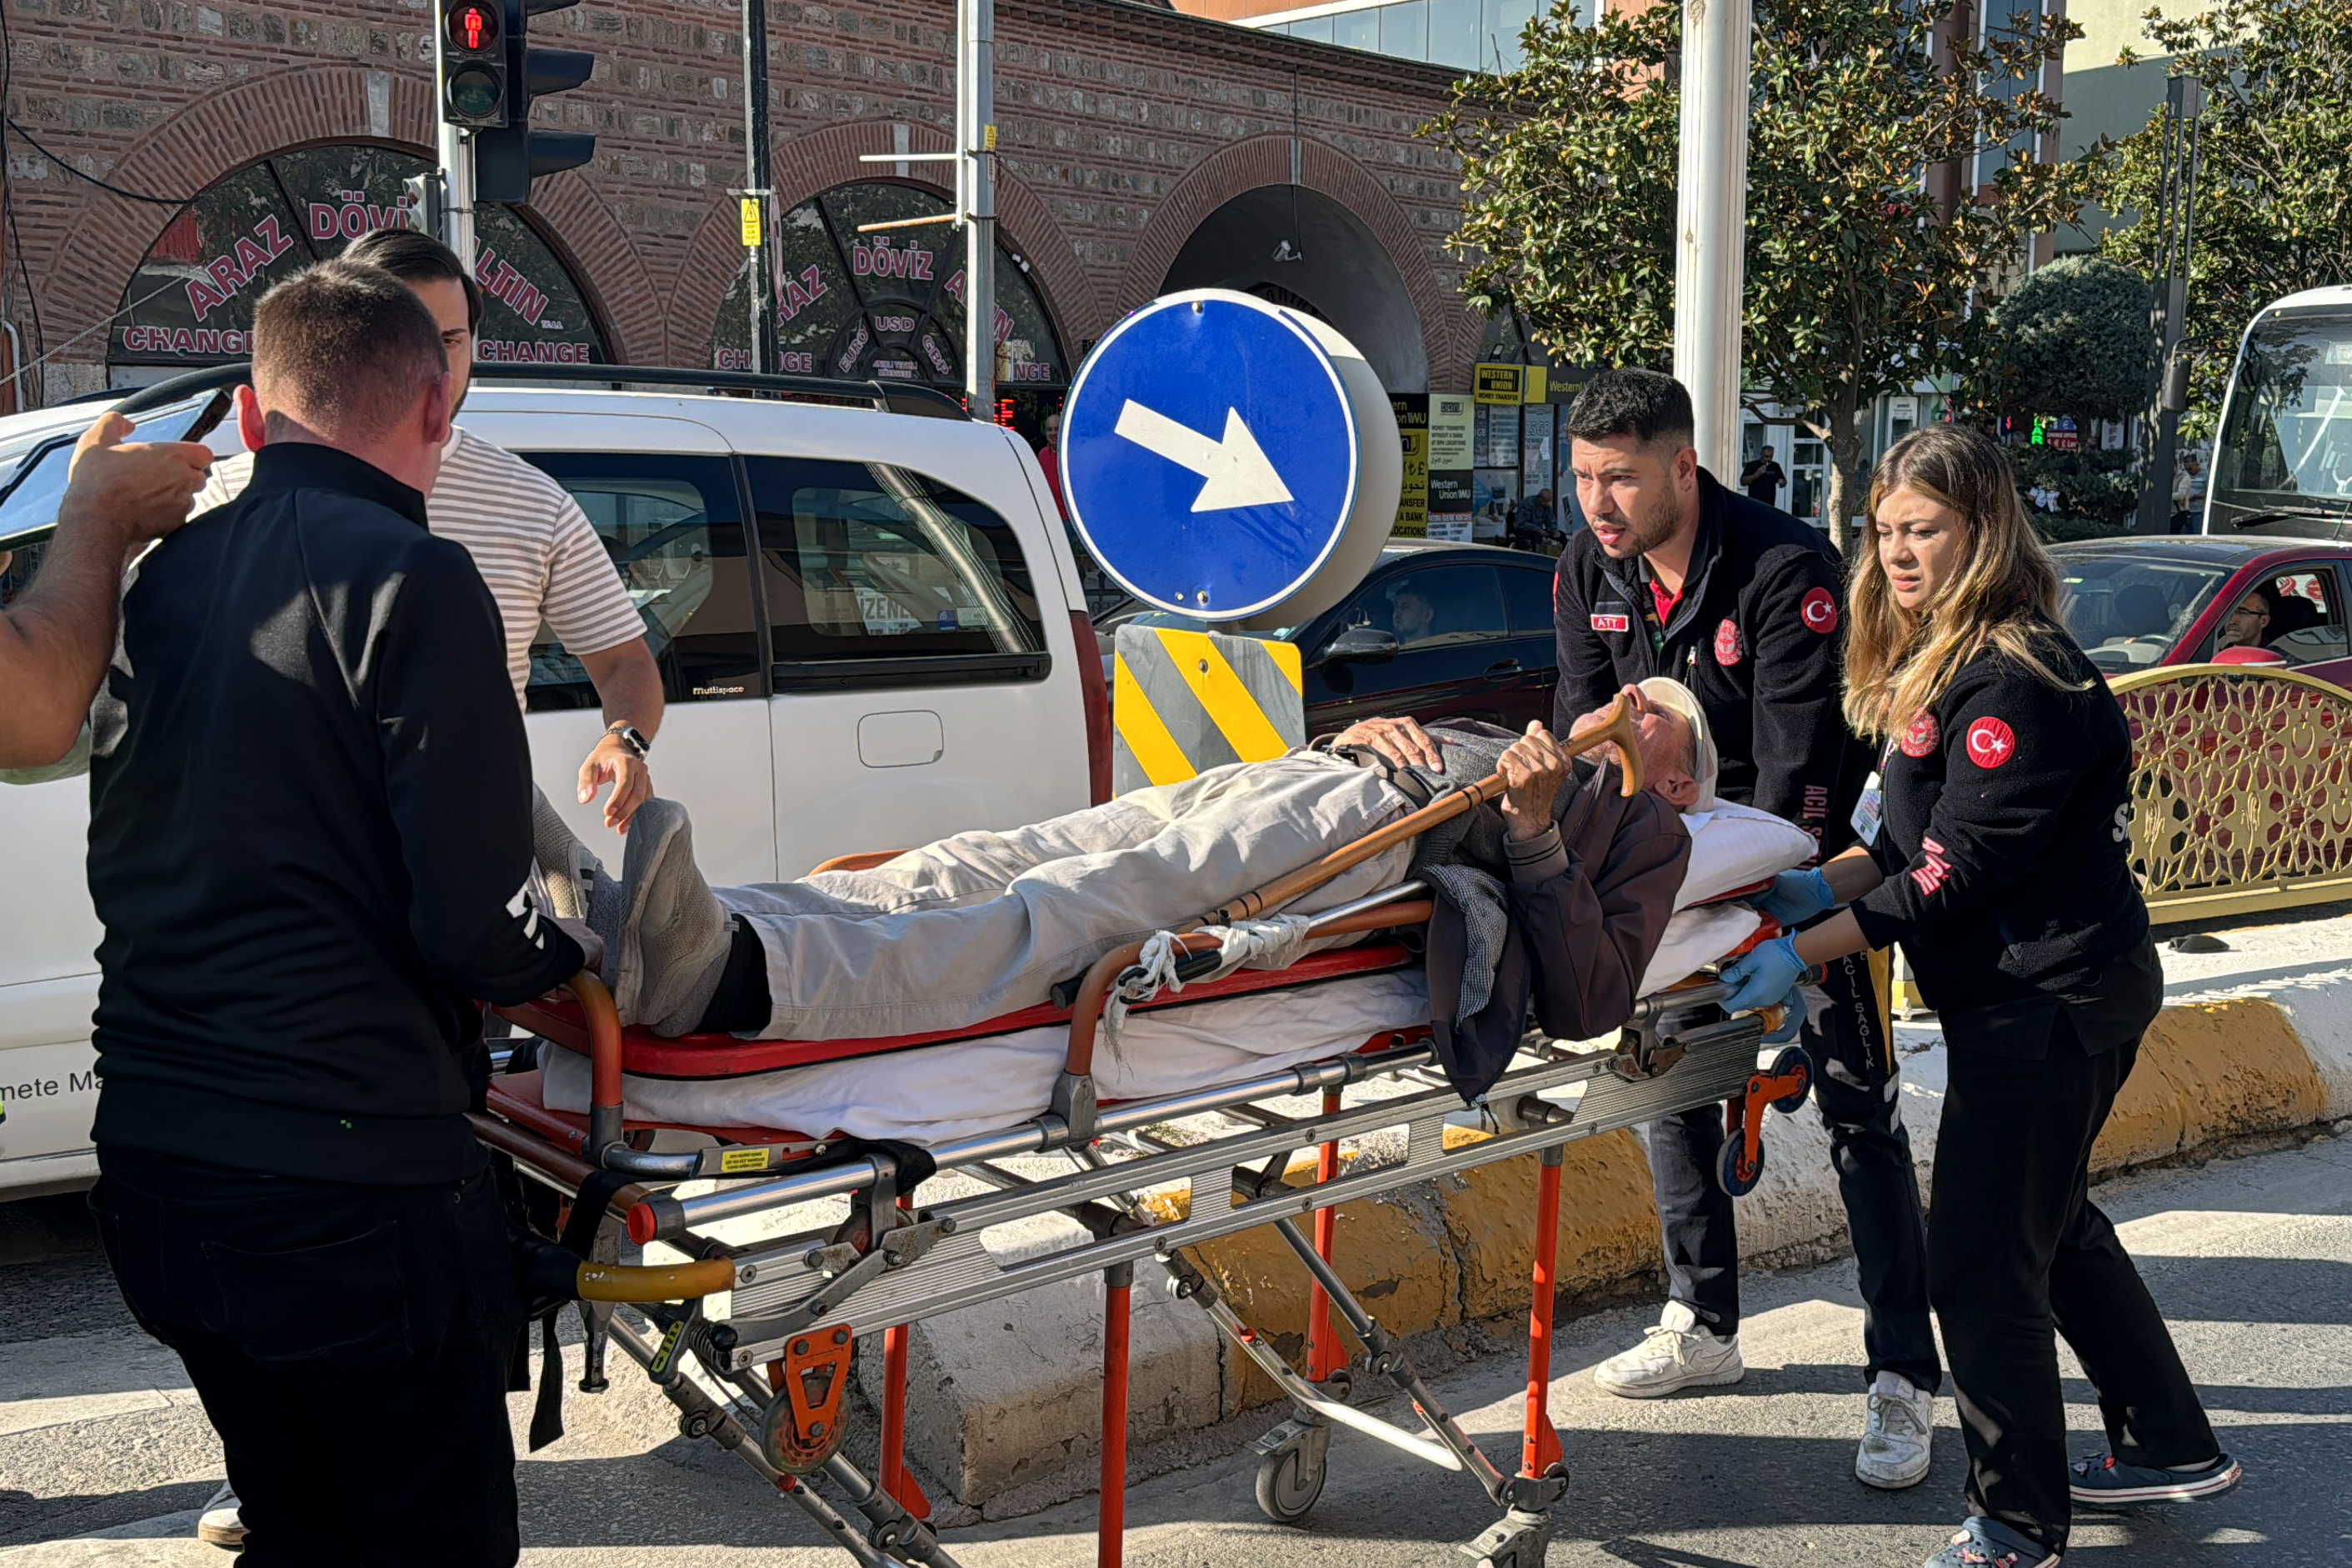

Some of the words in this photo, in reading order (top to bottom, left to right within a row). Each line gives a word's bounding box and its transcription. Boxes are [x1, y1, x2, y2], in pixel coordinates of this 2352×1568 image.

[309, 190, 407, 239] DÖVİ
[852, 236, 933, 281] DÖVİZ
[185, 213, 293, 322] ARAZ
[475, 236, 549, 326] LTIN
[875, 317, 915, 332] USD
[477, 339, 591, 364] CHANGE
[838, 329, 868, 373] EURO
[922, 335, 949, 375] GBP
[1481, 369, 1514, 379] WESTERN
[1491, 381, 1513, 391] UNION
[1431, 480, 1458, 489] Western
[1439, 490, 1457, 499] Union
[1400, 498, 1425, 507] ANSFER
[1406, 512, 1423, 522] BANK
[1597, 617, 1618, 628] ATT
